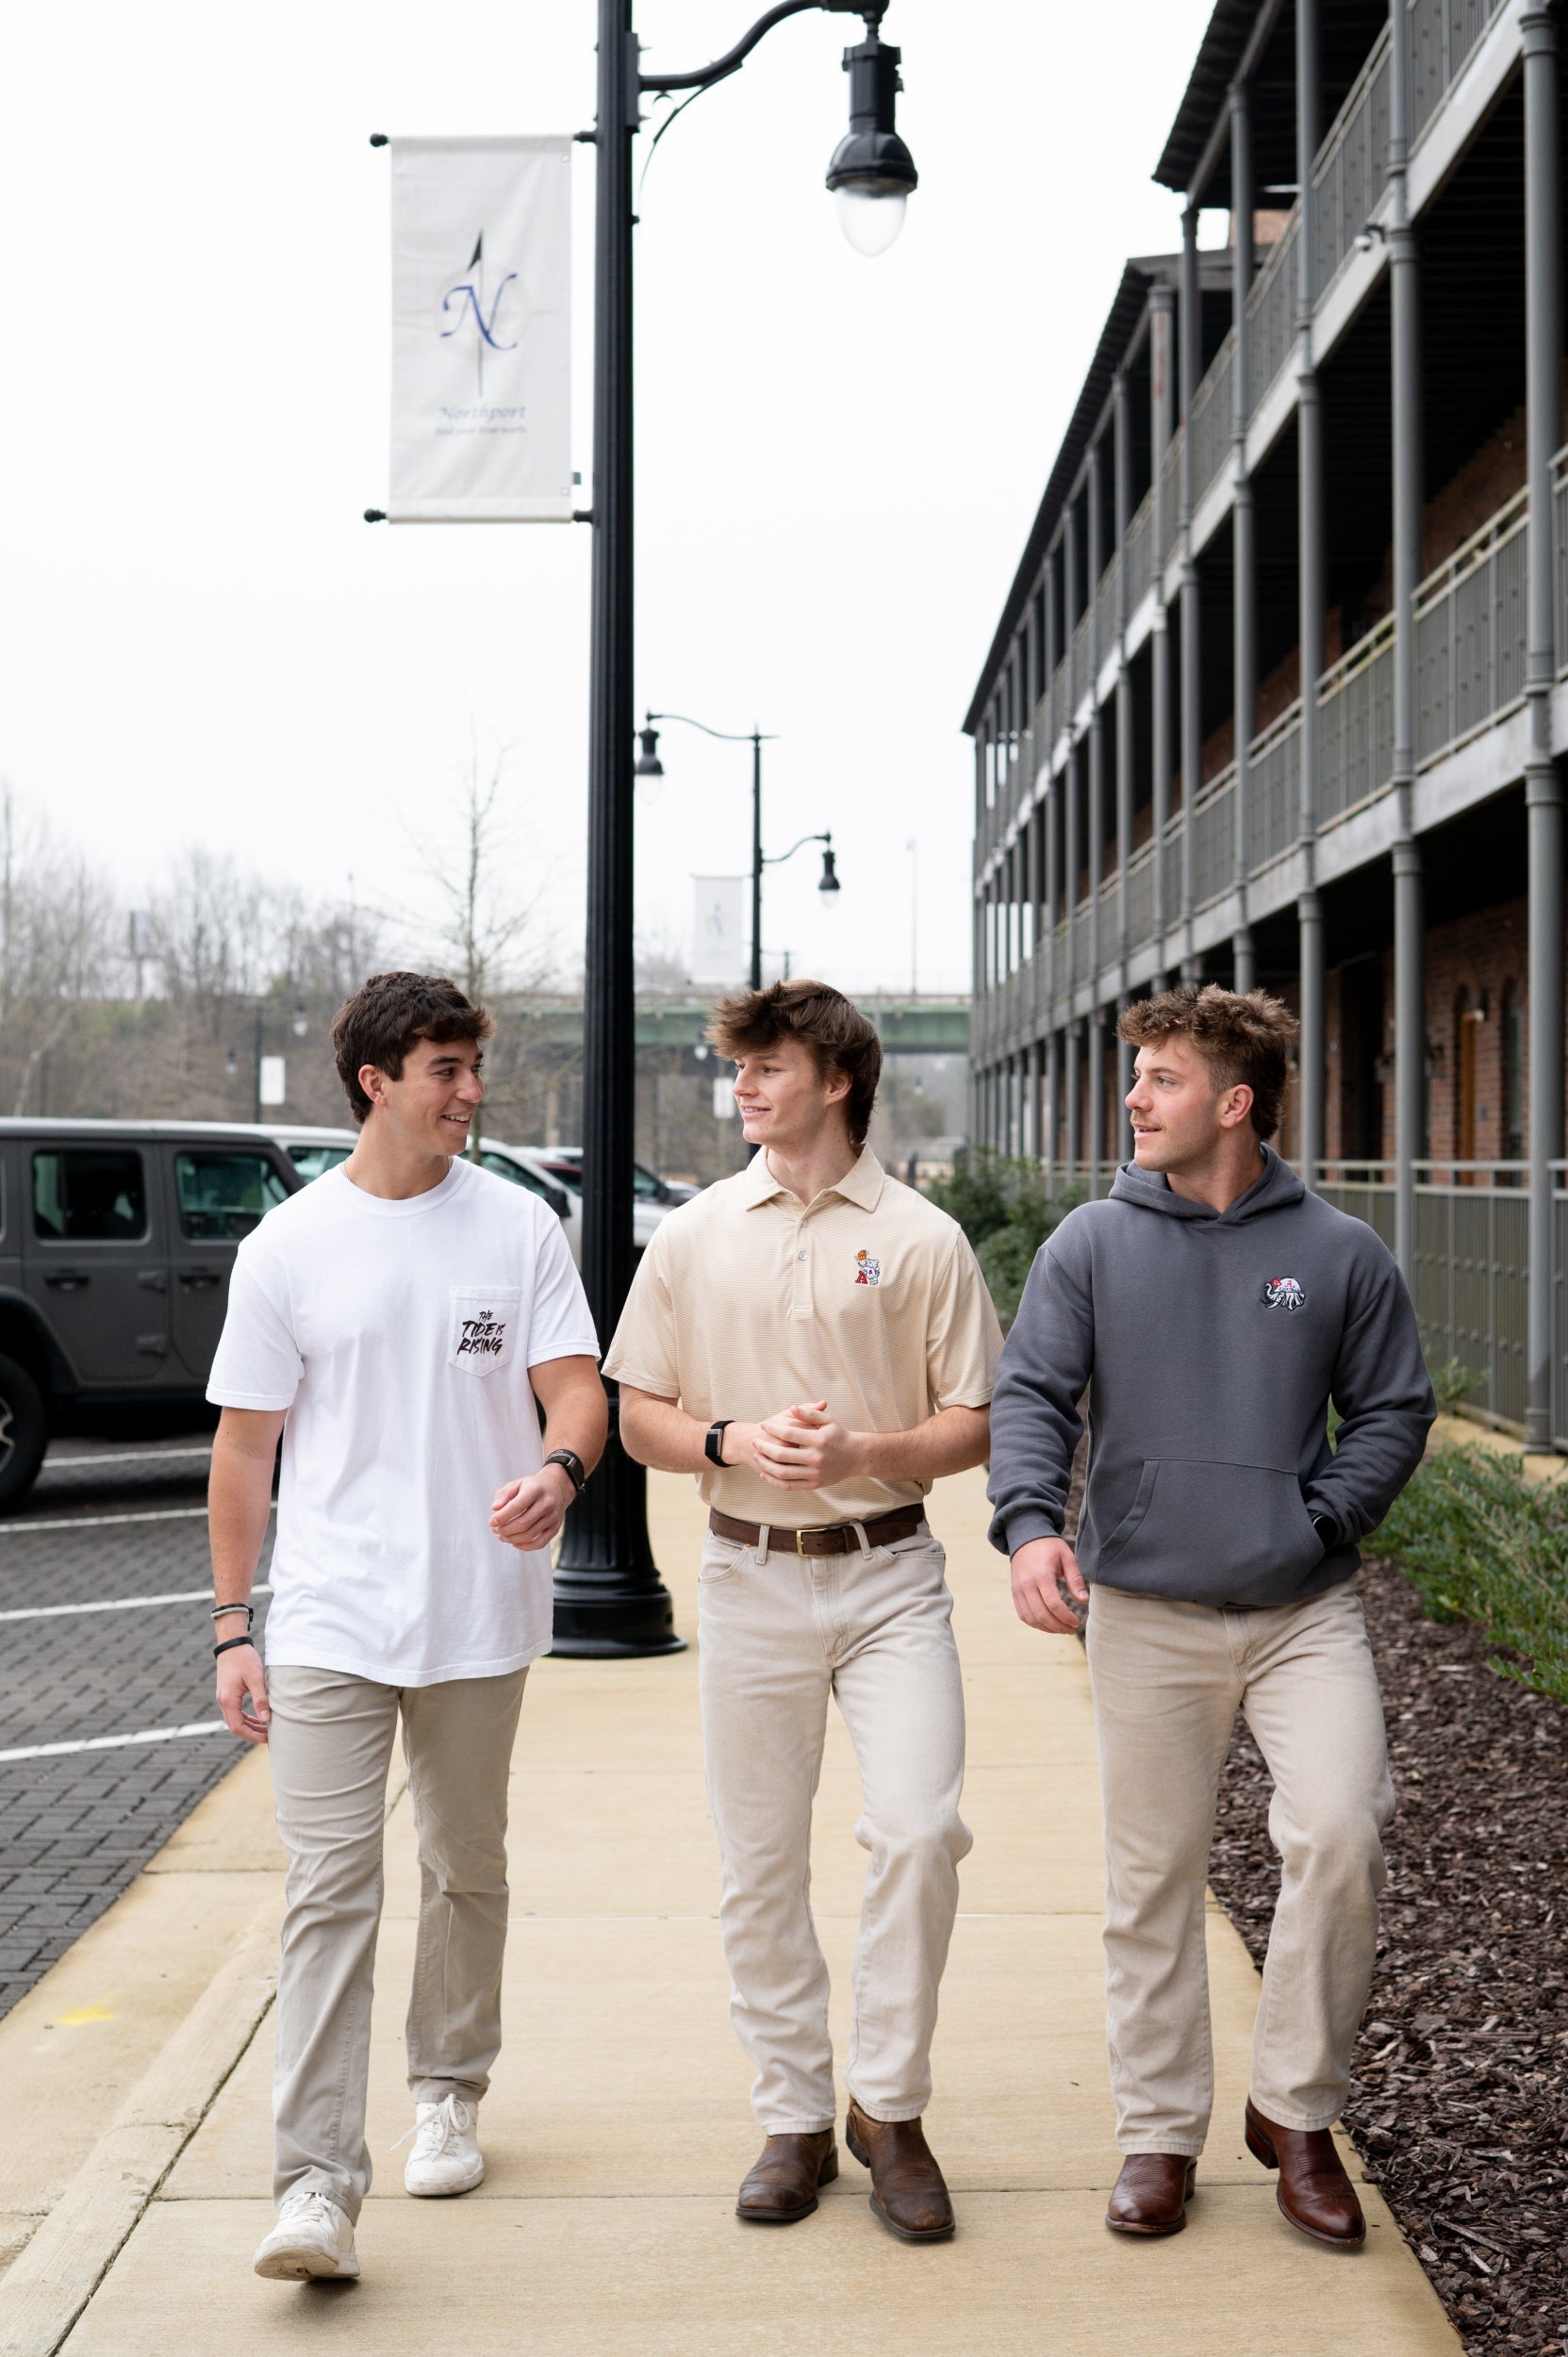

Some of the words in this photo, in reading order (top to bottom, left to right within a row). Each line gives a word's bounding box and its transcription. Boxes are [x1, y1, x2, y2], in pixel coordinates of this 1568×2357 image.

[440, 272, 518, 351] N
[855, 1270, 867, 1284] A
[479, 1310, 493, 1323] THE
[462, 1320, 498, 1337] TIDE
[495, 1323, 506, 1336] IS
[457, 1337, 503, 1356] RISING
